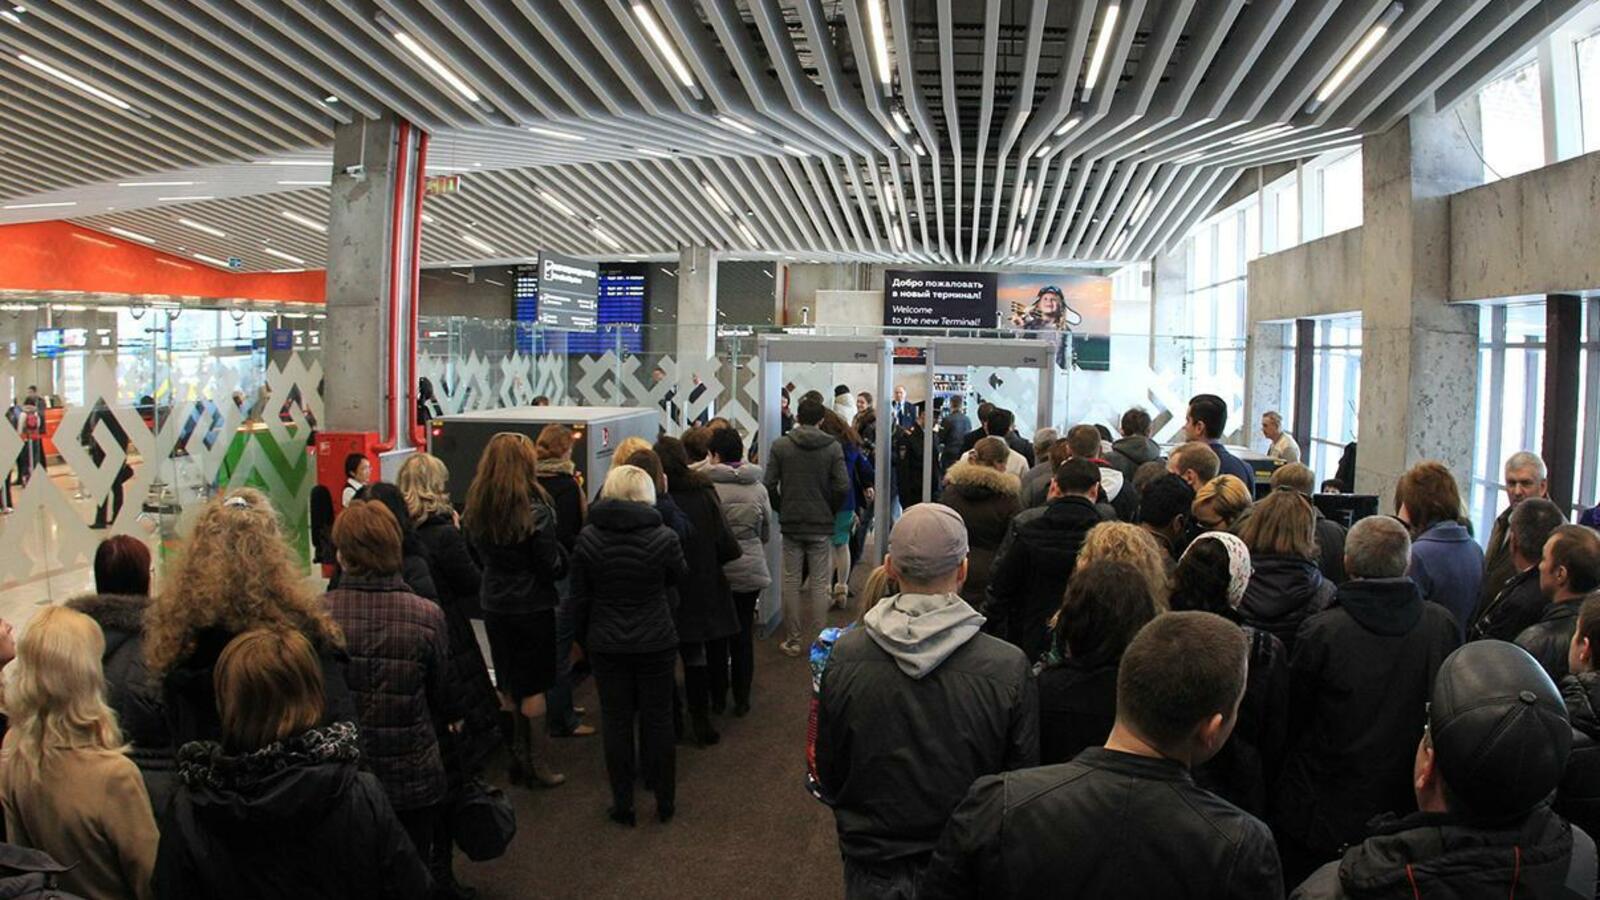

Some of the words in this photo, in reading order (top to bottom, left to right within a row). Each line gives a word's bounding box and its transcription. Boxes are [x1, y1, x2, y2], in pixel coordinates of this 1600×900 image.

[892, 278, 924, 288] Добро
[925, 280, 984, 289] пожаловать
[900, 290, 931, 298] новый
[932, 291, 982, 300] терминал!
[892, 305, 933, 314] Welcome
[892, 316, 902, 325] to
[903, 316, 919, 325] the
[941, 316, 981, 326] Terminal!
